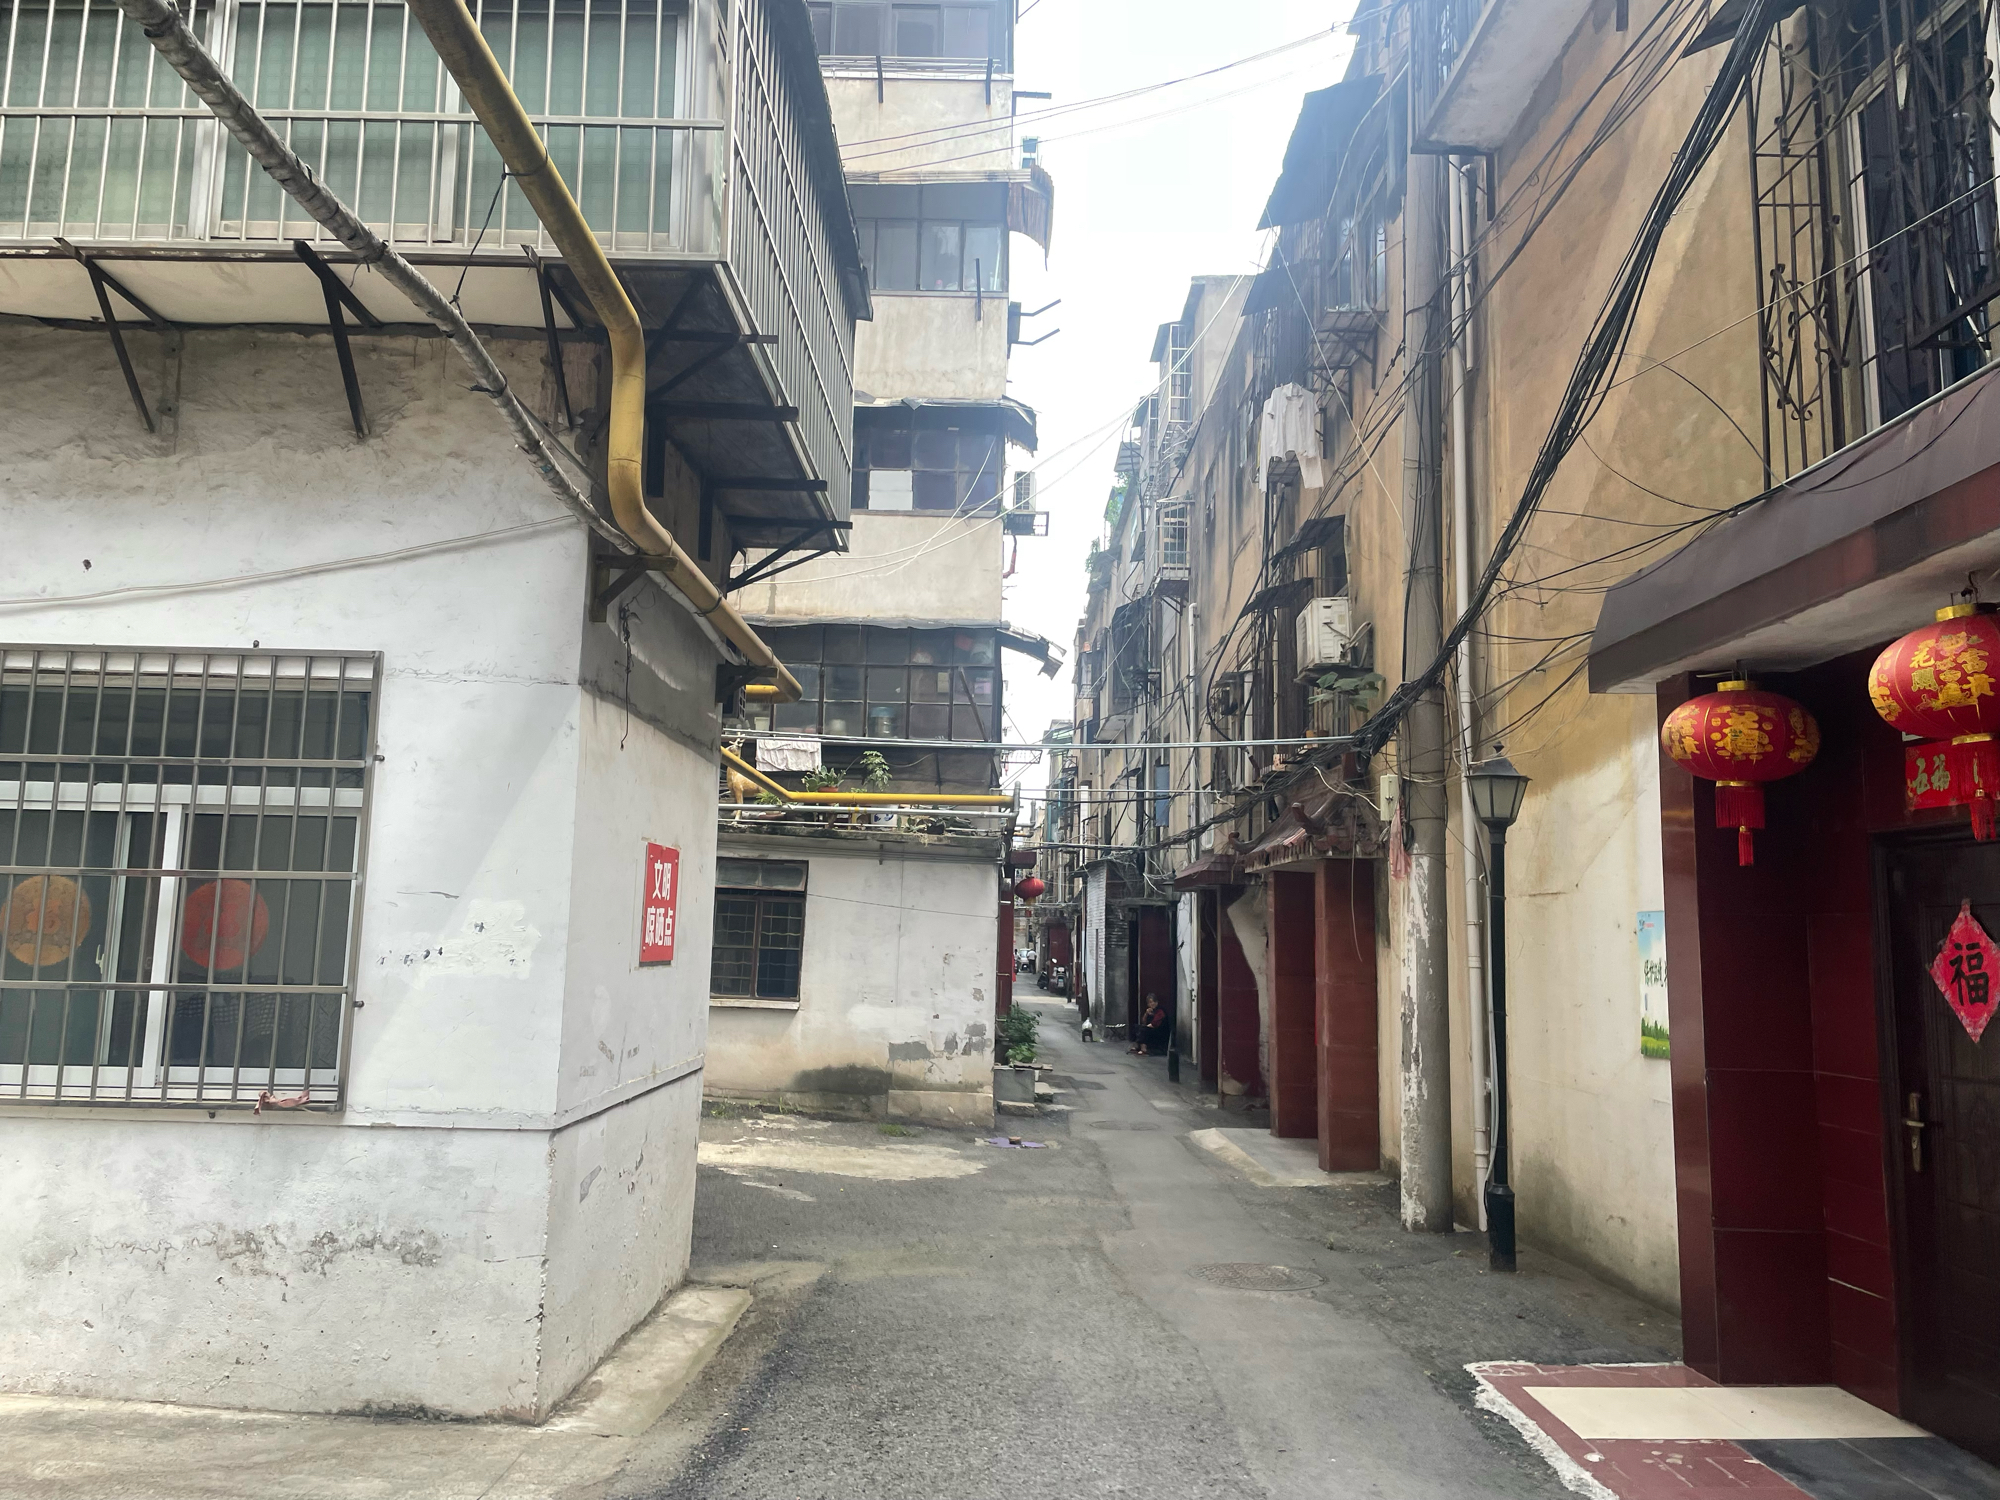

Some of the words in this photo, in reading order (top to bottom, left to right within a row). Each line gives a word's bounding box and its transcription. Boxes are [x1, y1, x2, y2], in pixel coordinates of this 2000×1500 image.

[1911, 753, 1979, 795] 五福
[652, 859, 672, 901] 文明
[1949, 942, 1990, 1006] 福
